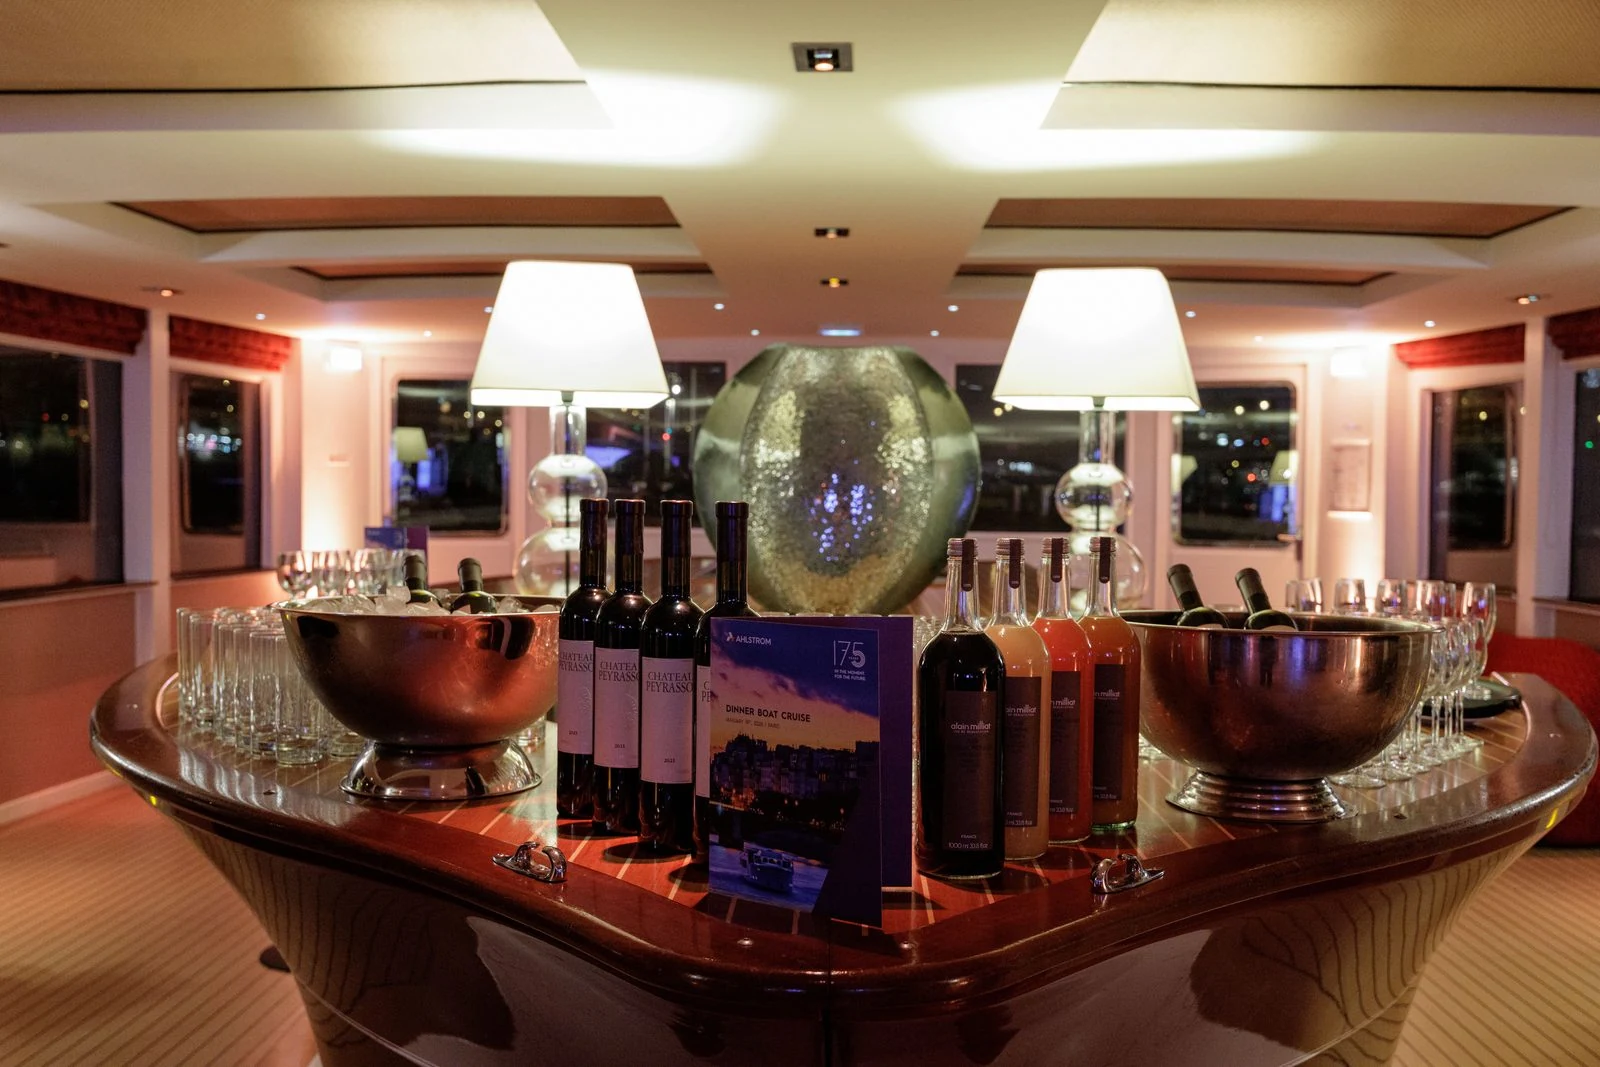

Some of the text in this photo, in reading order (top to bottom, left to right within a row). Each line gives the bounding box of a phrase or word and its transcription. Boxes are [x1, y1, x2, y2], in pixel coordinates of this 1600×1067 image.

[736, 635, 772, 646] AHLSTROM
[833, 640, 866, 668] 175
[726, 704, 811, 723] DINNER BOAT CRUISE
[951, 722, 969, 730] alain
